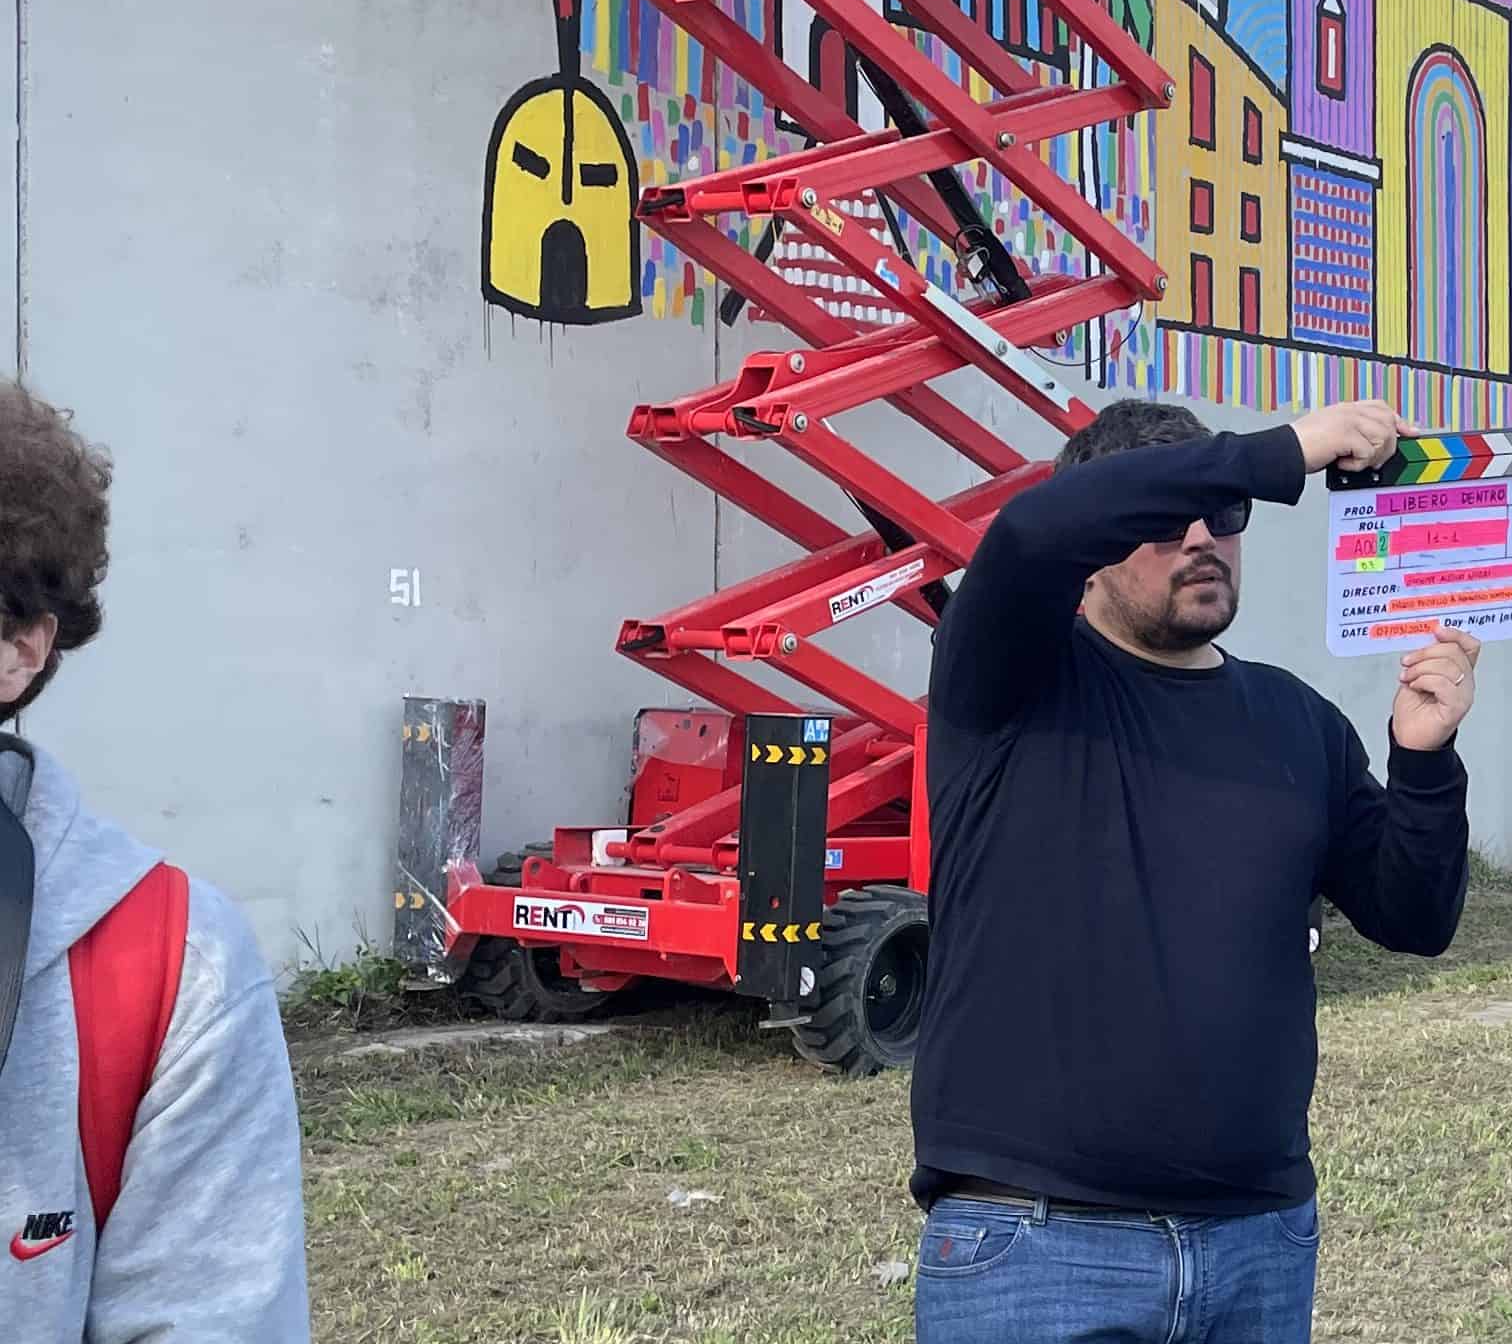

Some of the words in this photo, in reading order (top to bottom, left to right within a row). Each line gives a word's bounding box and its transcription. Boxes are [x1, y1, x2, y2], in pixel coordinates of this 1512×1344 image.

[1389, 493, 1449, 513] LIBERO
[1461, 489, 1506, 505] DENTRO
[1358, 519, 1386, 532] ROLL
[390, 568, 421, 607] 51
[1342, 584, 1401, 599] DIRECTOR:
[1443, 617, 1464, 628] Day
[1467, 614, 1496, 626] Night
[1341, 626, 1369, 639] DATE
[22, 1211, 75, 1241] NIKE
